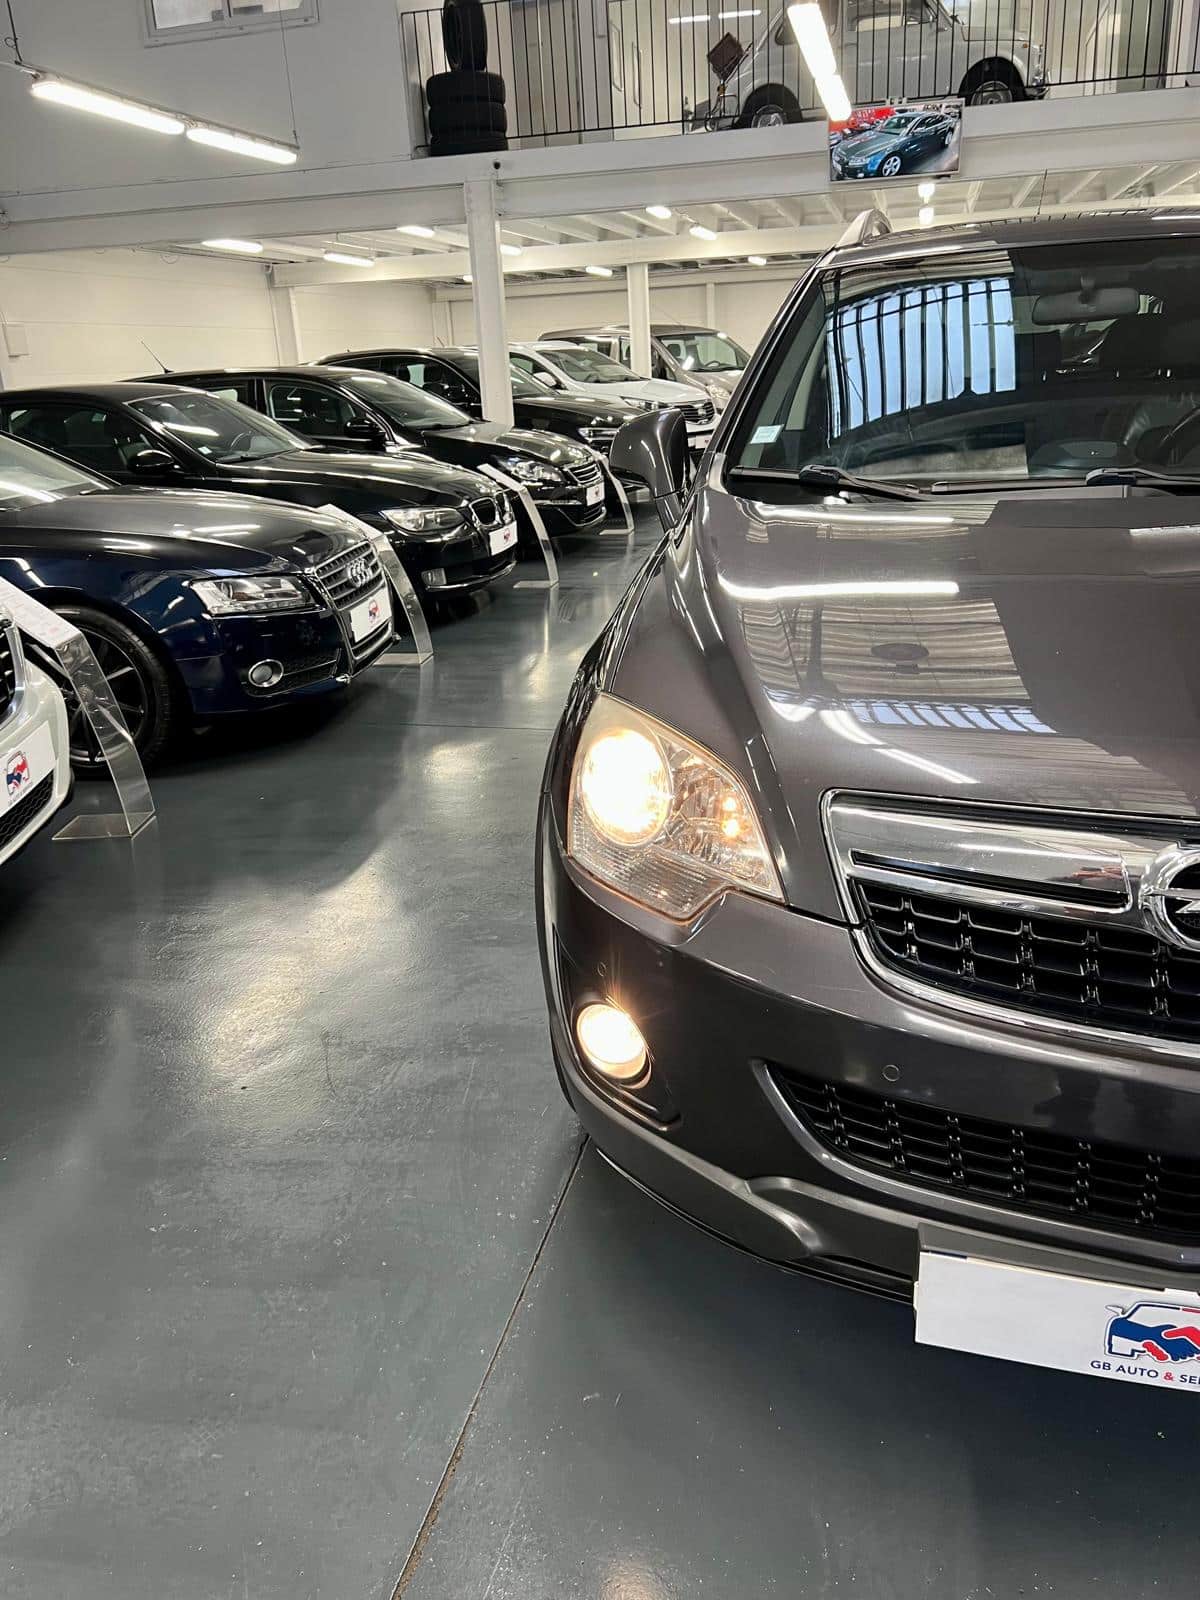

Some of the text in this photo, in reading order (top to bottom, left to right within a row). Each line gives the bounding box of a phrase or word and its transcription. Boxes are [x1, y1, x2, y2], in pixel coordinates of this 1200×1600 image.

[1090, 1360, 1200, 1385] GB AUTO & SE
